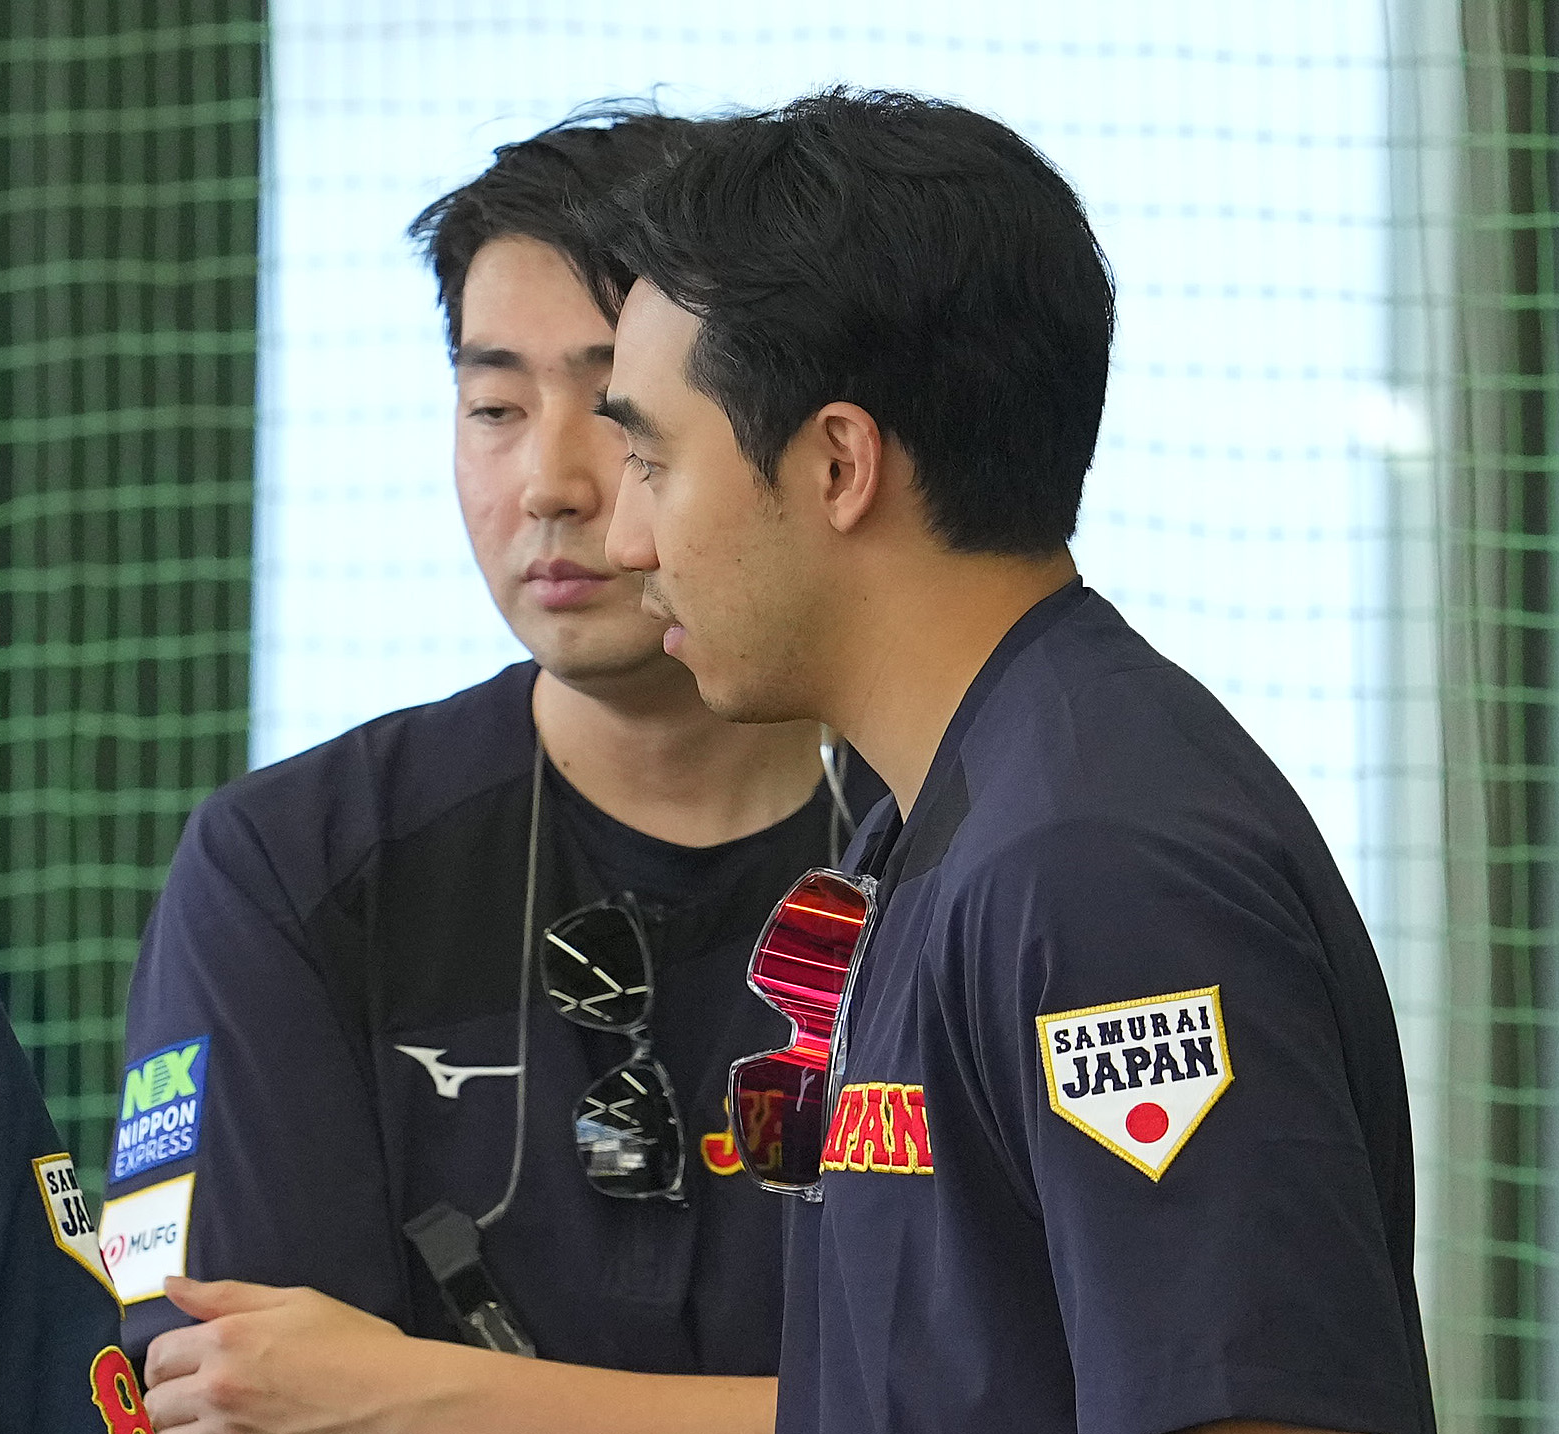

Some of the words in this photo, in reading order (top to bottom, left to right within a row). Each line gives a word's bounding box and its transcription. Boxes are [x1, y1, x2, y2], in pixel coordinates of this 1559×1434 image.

[1054, 1005, 1211, 1054] SAMURAI
[121, 1043, 201, 1121] NX
[1062, 1036, 1218, 1099] JAPAN
[114, 1126, 193, 1178] EXPRESS
[117, 1099, 197, 1153] NIPPON
[127, 1223, 177, 1257] MUFG
